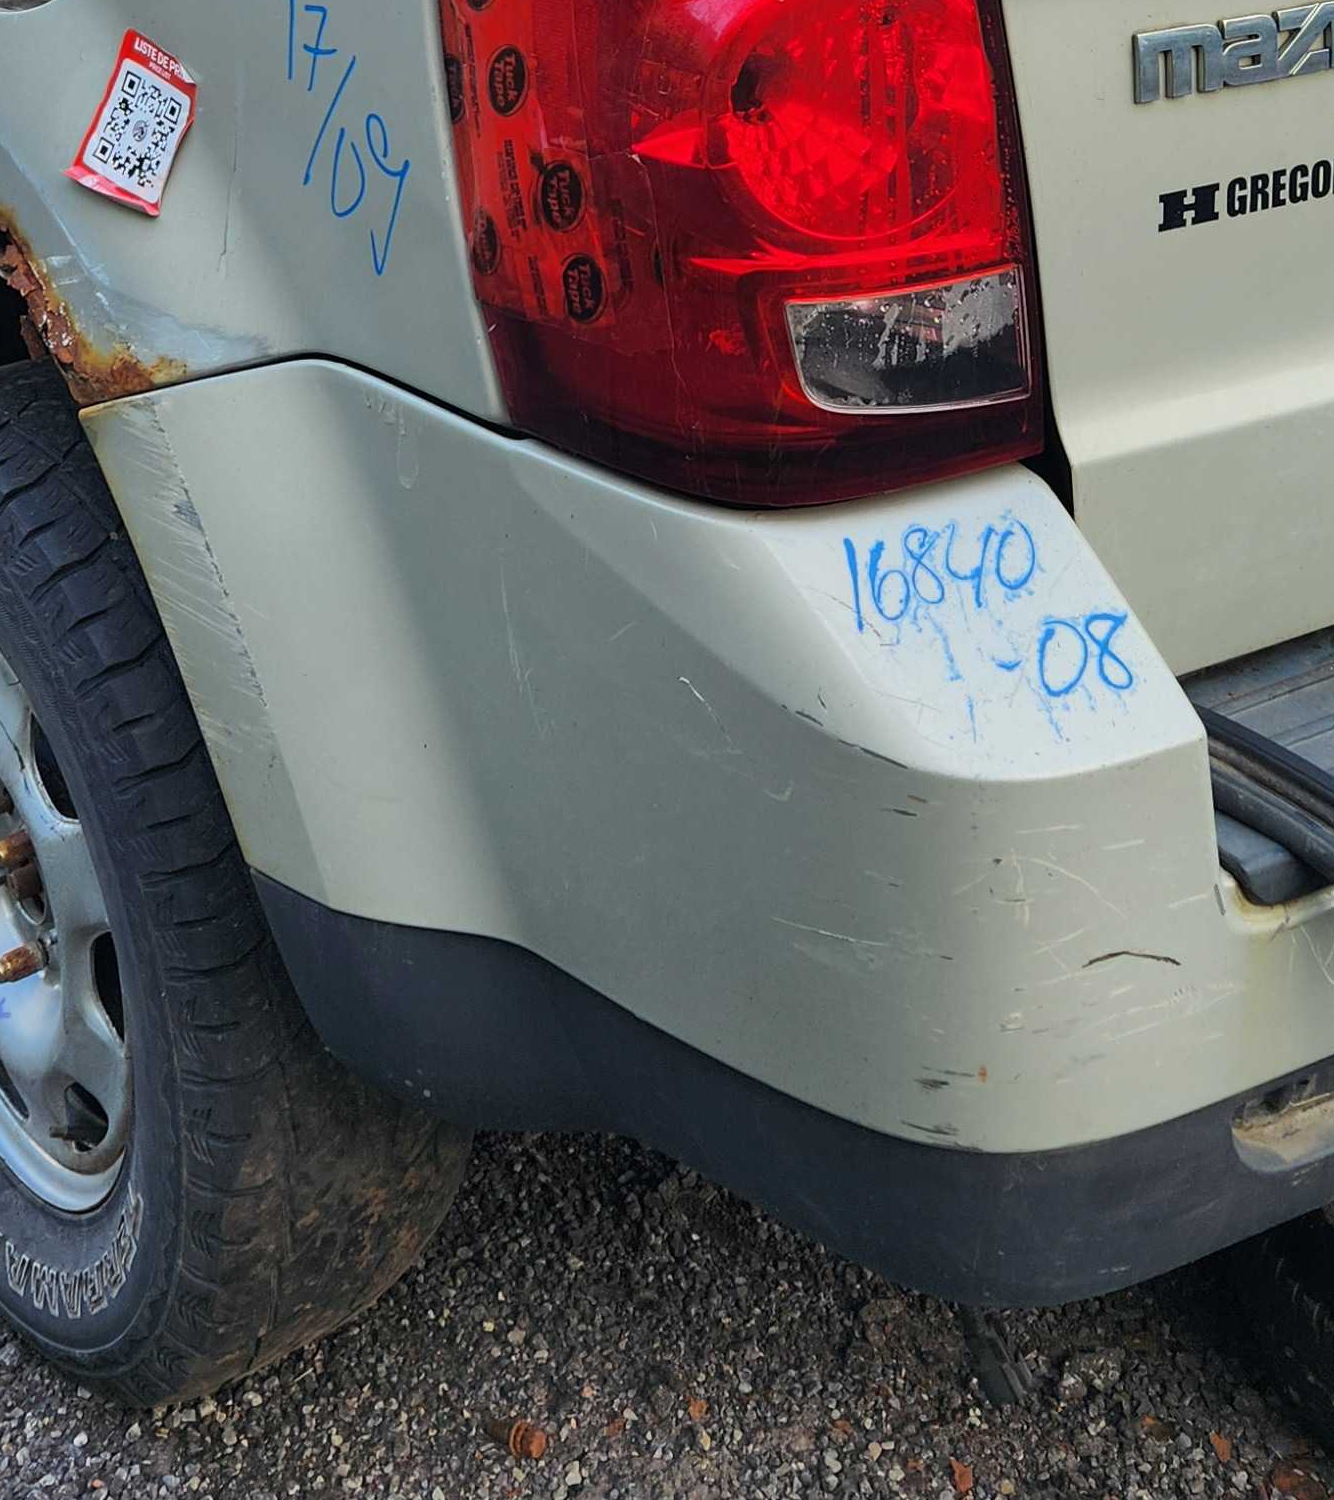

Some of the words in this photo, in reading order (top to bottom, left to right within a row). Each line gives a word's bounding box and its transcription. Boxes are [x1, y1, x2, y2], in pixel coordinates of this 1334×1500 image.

[134, 36, 158, 61] LISTE
[157, 51, 170, 70] DE
[505, 53, 517, 101] Tuck
[493, 60, 506, 107] Tape
[548, 175, 563, 224] Tape
[557, 169, 574, 218] Tuck
[1158, 182, 1220, 233] H
[567, 268, 582, 315] Tape
[578, 263, 595, 309] Tuck
[842, 517, 1037, 634] 16840
